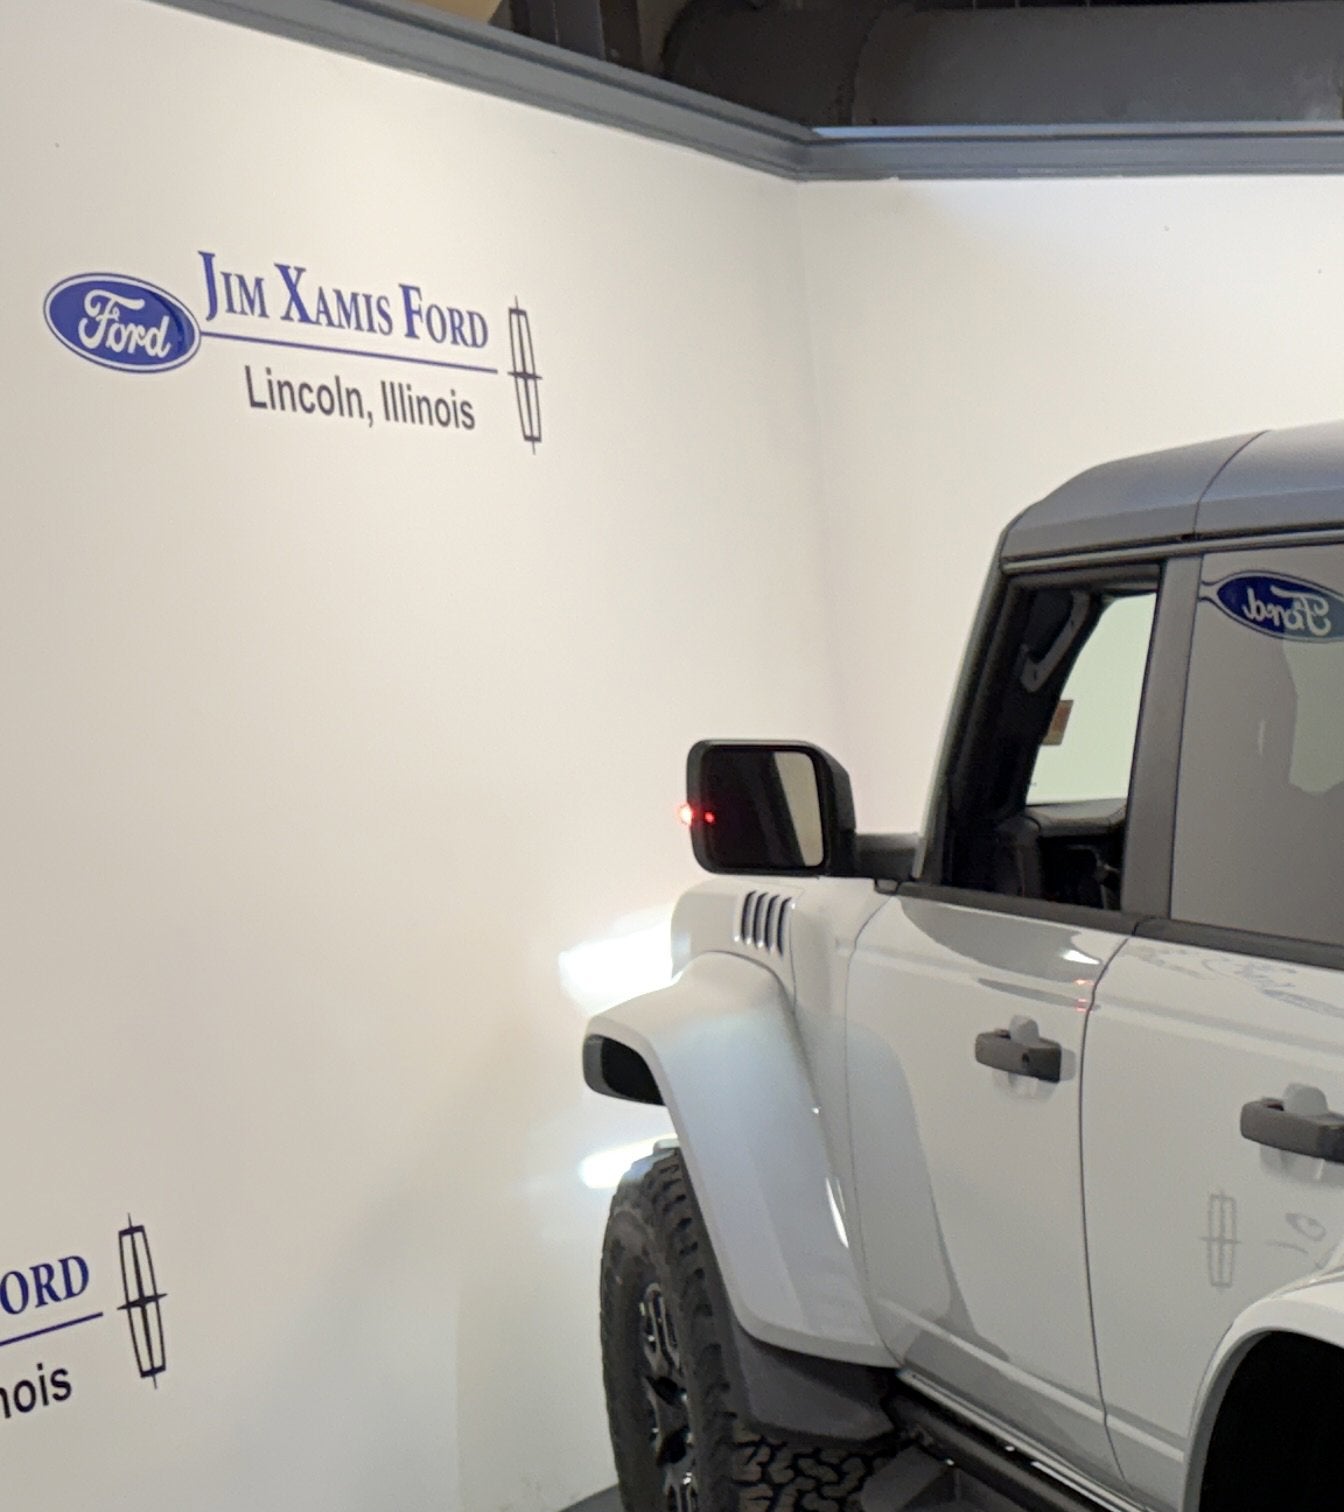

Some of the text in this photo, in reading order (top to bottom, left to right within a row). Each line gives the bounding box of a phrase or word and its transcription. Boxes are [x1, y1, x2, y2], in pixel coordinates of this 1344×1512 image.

[77, 289, 171, 358] Ford
[198, 250, 489, 349] JIM XAMIS FORD
[245, 365, 476, 430] Lincoln, Illinois
